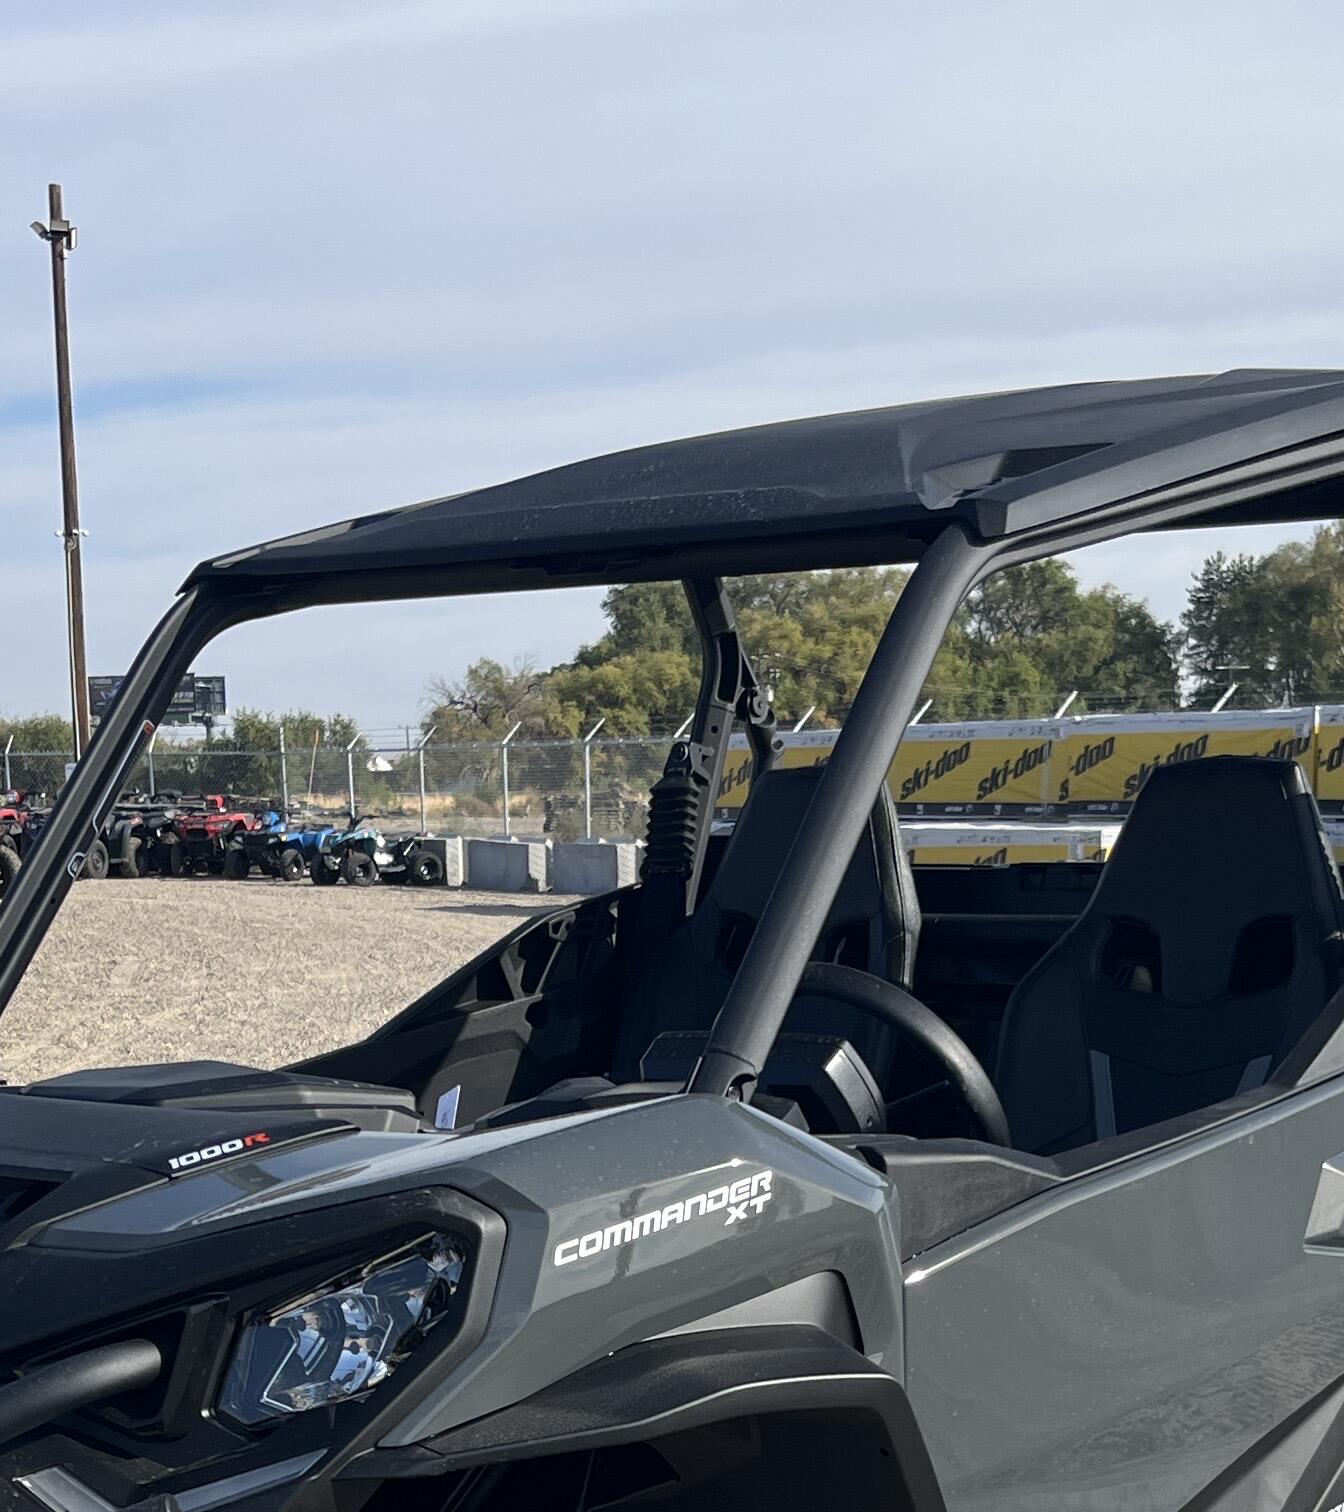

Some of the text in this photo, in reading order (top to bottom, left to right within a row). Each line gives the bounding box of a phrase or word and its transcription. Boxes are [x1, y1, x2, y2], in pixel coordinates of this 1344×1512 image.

[900, 741, 971, 800] ski-doo
[976, 740, 1052, 800] ski-doo
[168, 1133, 270, 1169] 1000R
[554, 1170, 772, 1266] COMMANDER
[725, 1192, 772, 1226] XT
